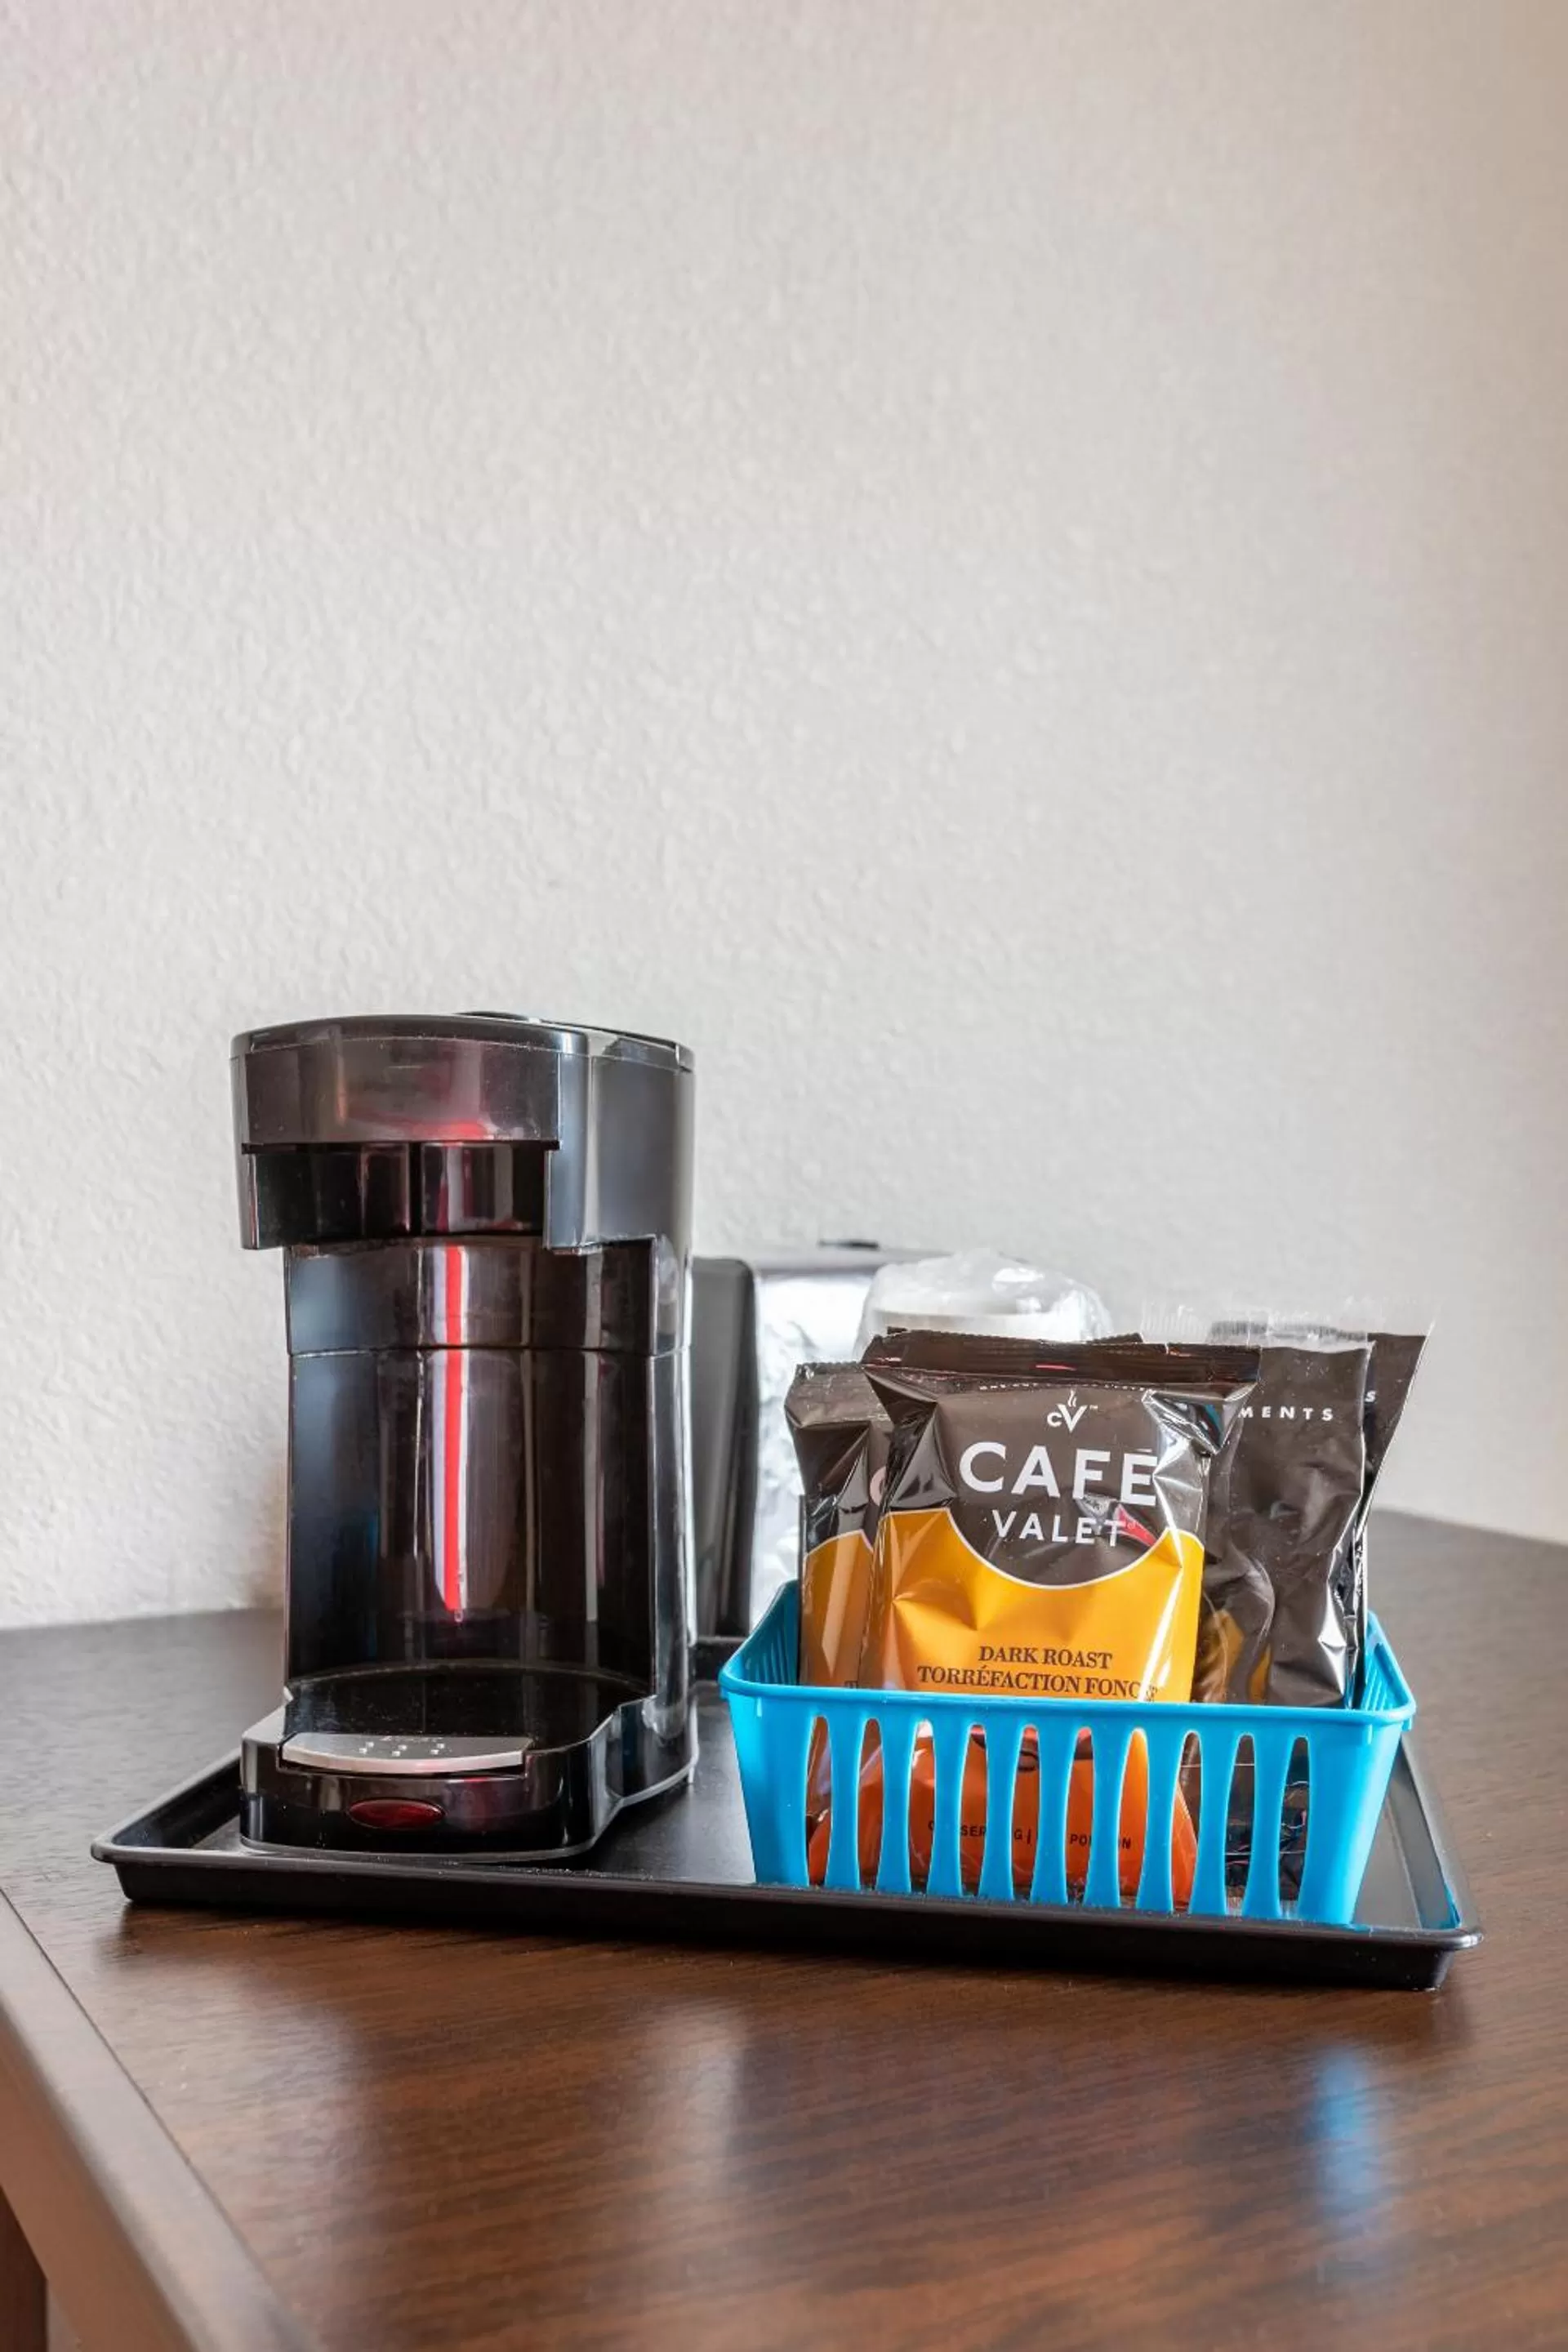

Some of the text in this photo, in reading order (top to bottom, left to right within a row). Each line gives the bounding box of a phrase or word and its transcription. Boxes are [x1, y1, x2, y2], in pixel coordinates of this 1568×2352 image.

[991, 1509, 1126, 1548] VALET
[978, 1646, 1112, 1670] DARK ROAST
[916, 1663, 1158, 1702] TORRÉFACTION FONC
